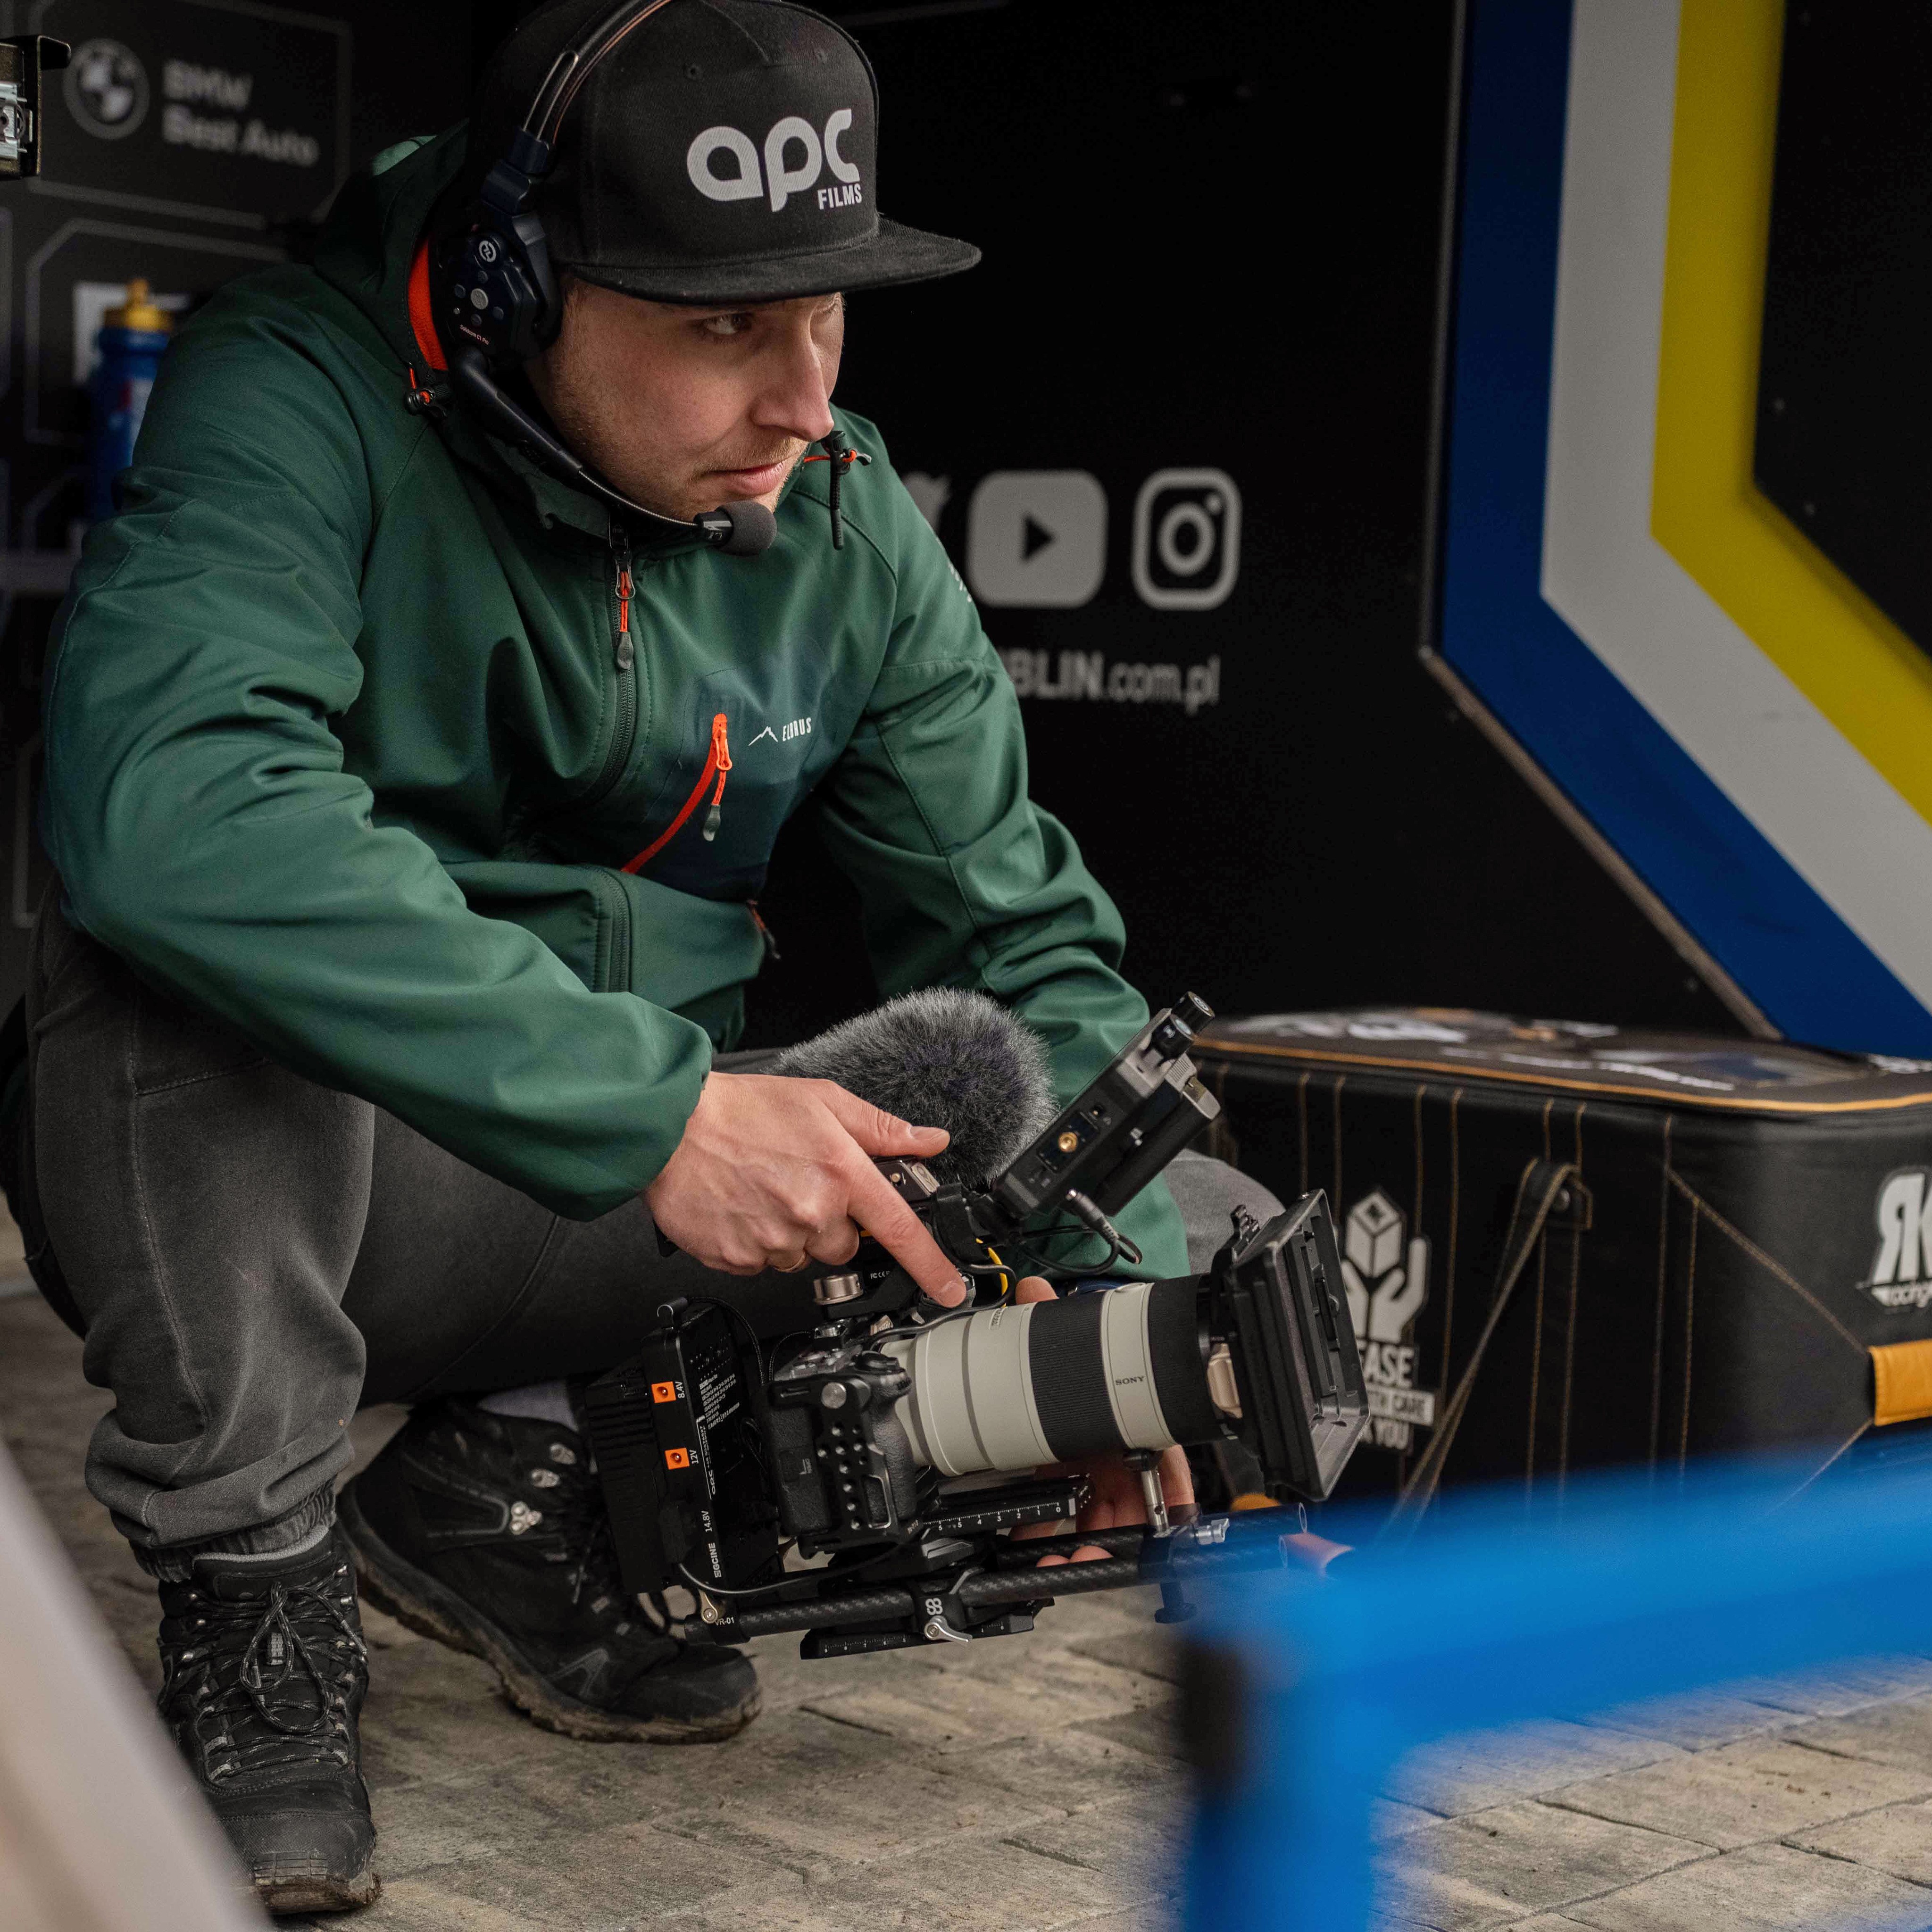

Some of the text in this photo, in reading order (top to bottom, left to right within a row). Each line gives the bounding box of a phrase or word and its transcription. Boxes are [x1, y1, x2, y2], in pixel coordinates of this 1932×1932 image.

[162, 59, 253, 112] BMW
[162, 103, 320, 167] Best Auto
[687, 108, 860, 212] apc
[817, 183, 863, 210] FILMS
[675, 1381, 685, 1399] 8.4V
[1115, 1376, 1144, 1386] SONY
[689, 1450, 699, 1465] 12V
[701, 1510, 713, 1532] 14.8V
[715, 1616, 735, 1626] VR-01
